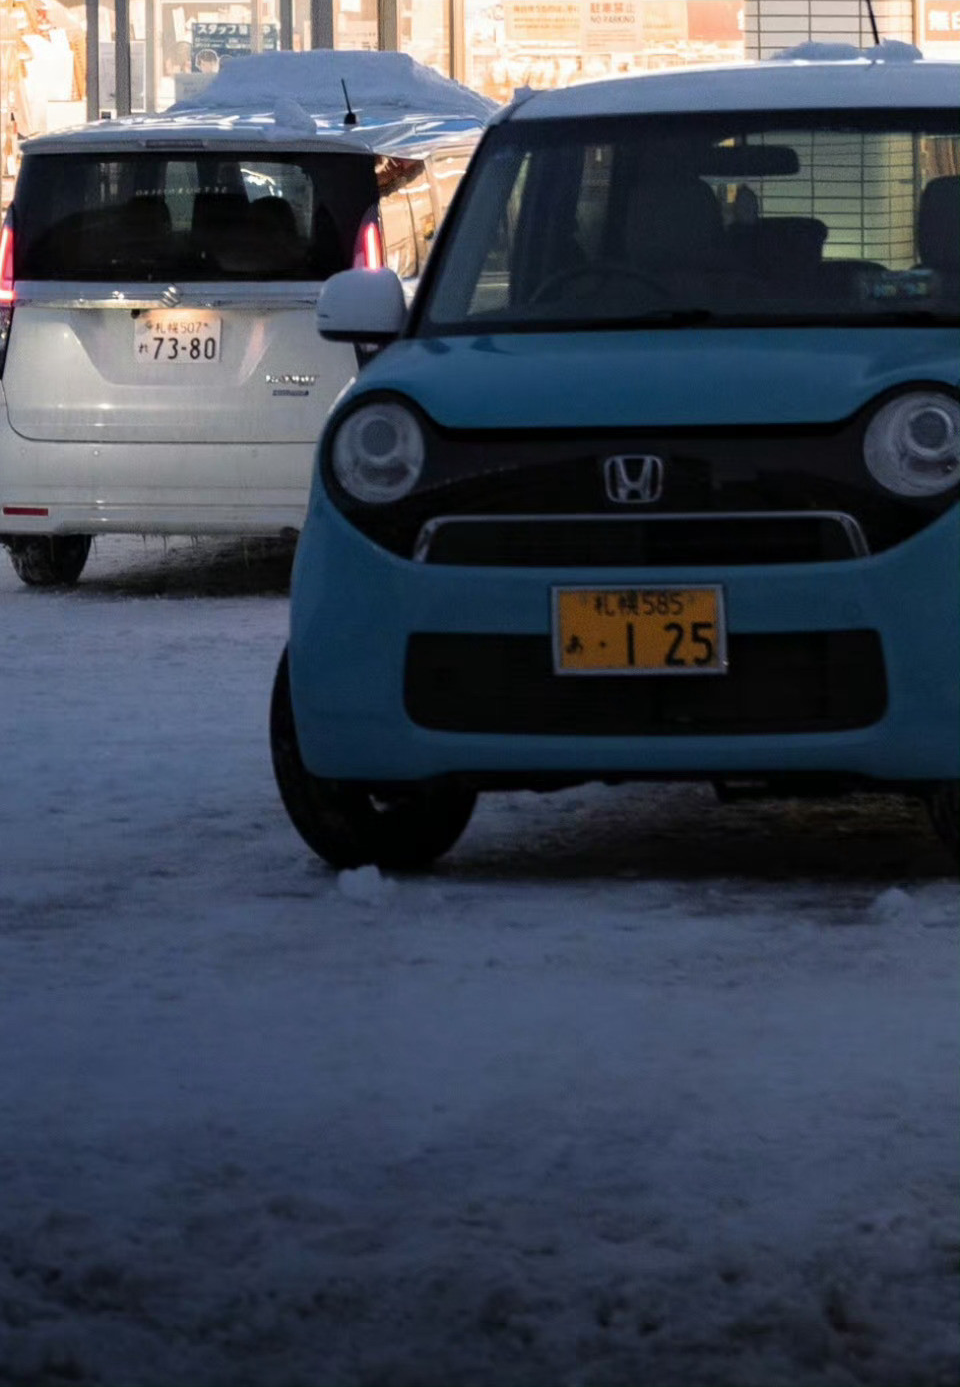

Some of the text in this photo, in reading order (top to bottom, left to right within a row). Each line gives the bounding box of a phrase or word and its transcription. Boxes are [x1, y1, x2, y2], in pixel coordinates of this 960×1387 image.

[591, 3, 635, 13] 駐車禁止
[591, 16, 635, 24] NO PARKING
[198, 24, 271, 35] スタッフ募中
[153, 337, 216, 360] 73-80
